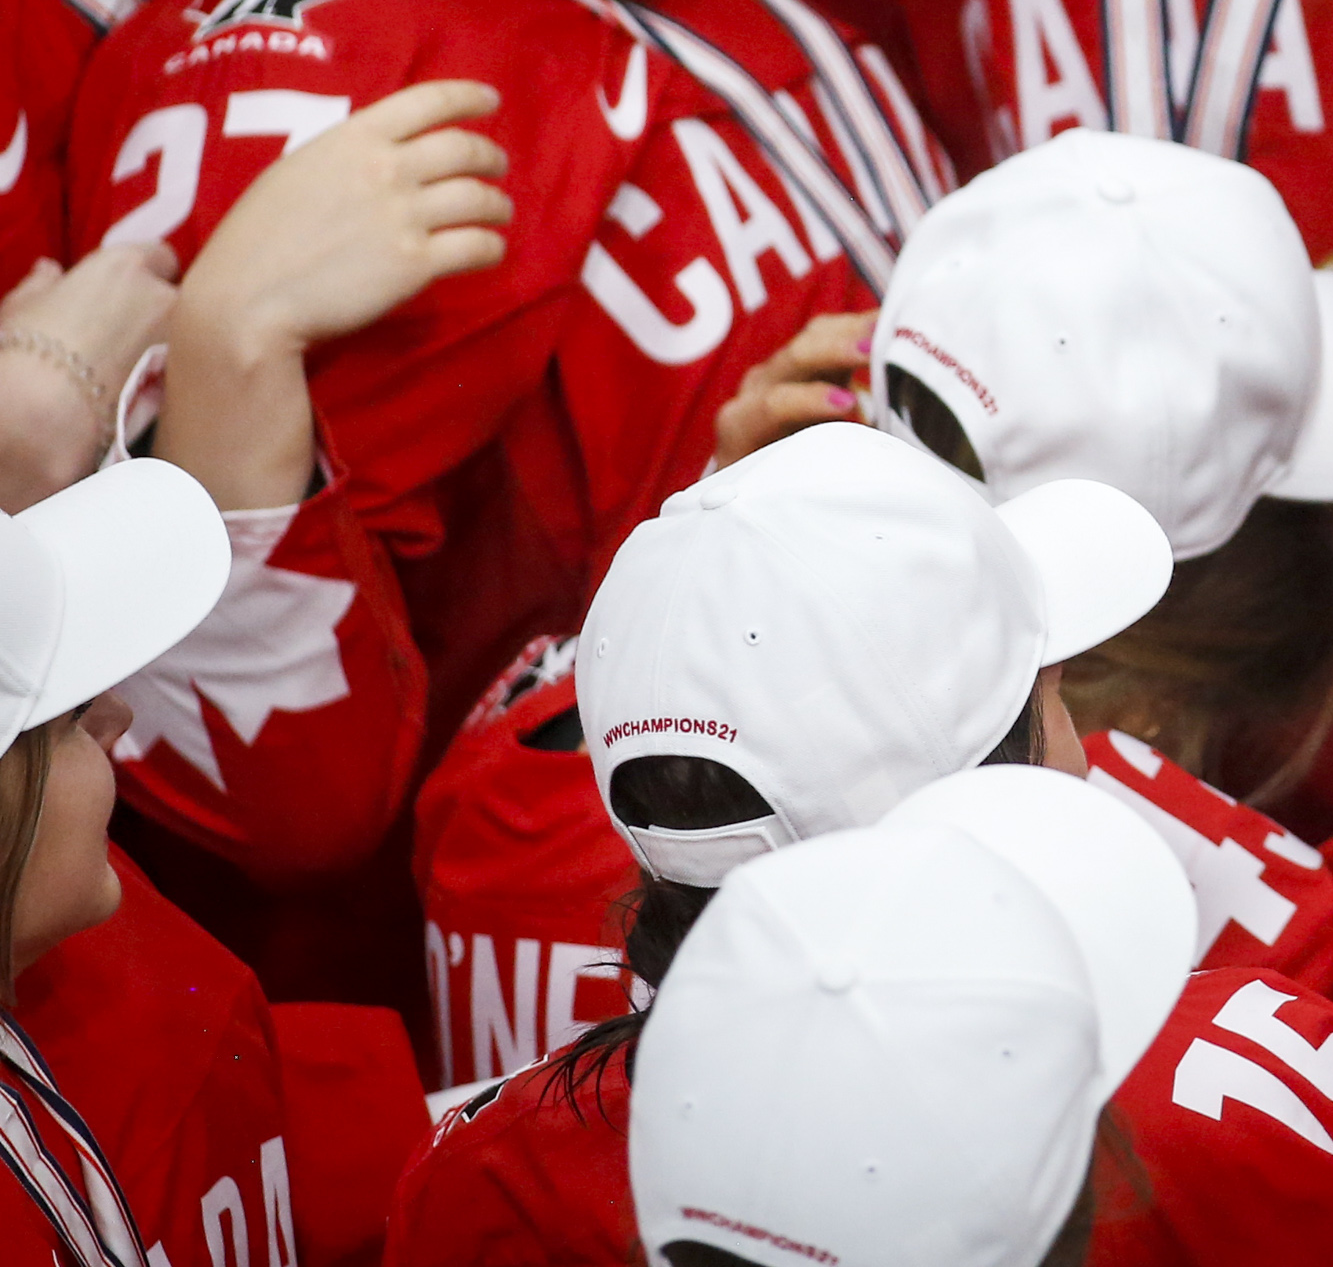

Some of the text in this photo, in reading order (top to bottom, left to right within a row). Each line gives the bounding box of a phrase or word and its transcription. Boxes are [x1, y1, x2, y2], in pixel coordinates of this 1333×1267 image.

[164, 31, 328, 75] CANADA
[101, 89, 351, 249] 27
[603, 717, 738, 749] WWCHAMPIONS21
